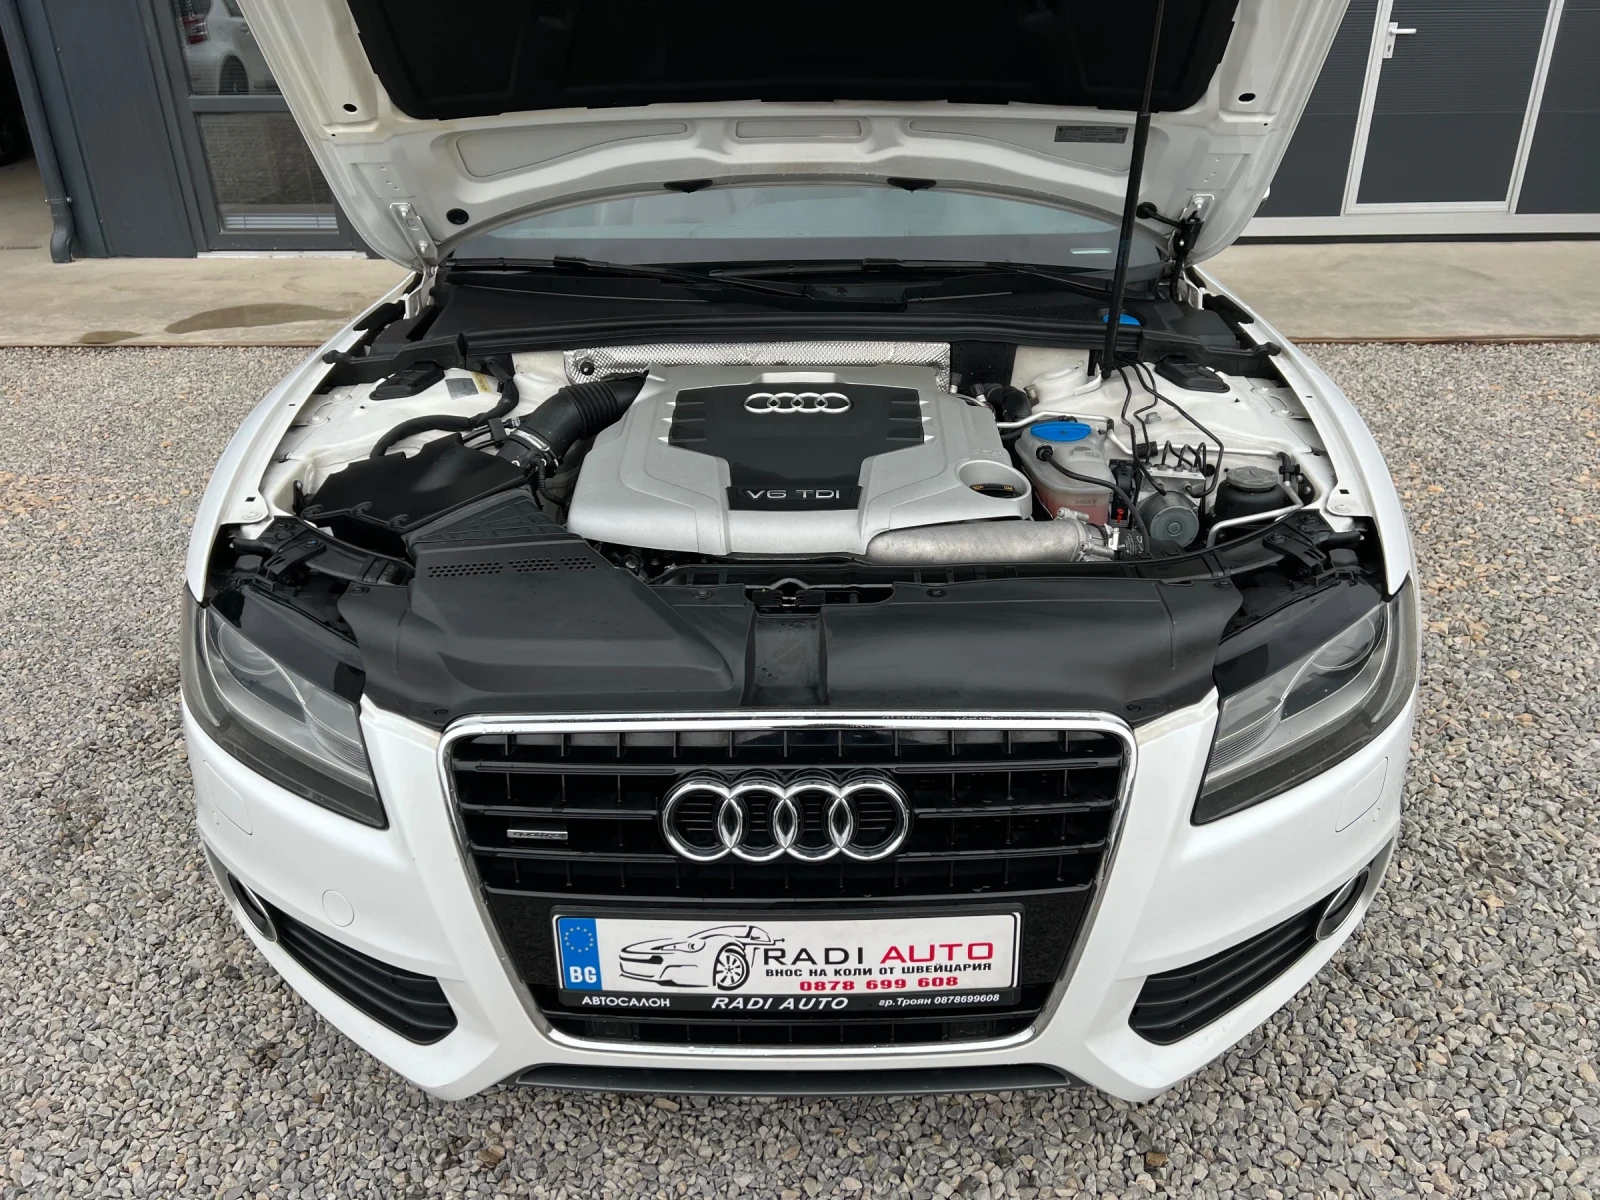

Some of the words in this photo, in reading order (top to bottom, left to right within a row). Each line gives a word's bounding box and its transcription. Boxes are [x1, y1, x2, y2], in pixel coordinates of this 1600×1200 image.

[746, 489, 787, 499] V6
[795, 489, 840, 499] TDI
[763, 946, 864, 966] RADI
[879, 942, 994, 965] AUTO
[569, 965, 597, 984] BG
[765, 968, 803, 977] ВНОС
[808, 968, 828, 977] НА
[833, 967, 873, 977] КОЛИ
[878, 966, 896, 976] ОТ
[901, 962, 992, 975] ШВЕЙЦАРИЯ
[799, 980, 855, 992] 0878
[865, 978, 907, 990] 699
[917, 976, 959, 988] 608
[581, 995, 671, 1008] АВТОСАЛОН
[711, 996, 774, 1010] RADI
[778, 996, 849, 1010] AUTO
[878, 996, 932, 1007] гр.Троян
[933, 993, 1000, 1005] 0878699608
